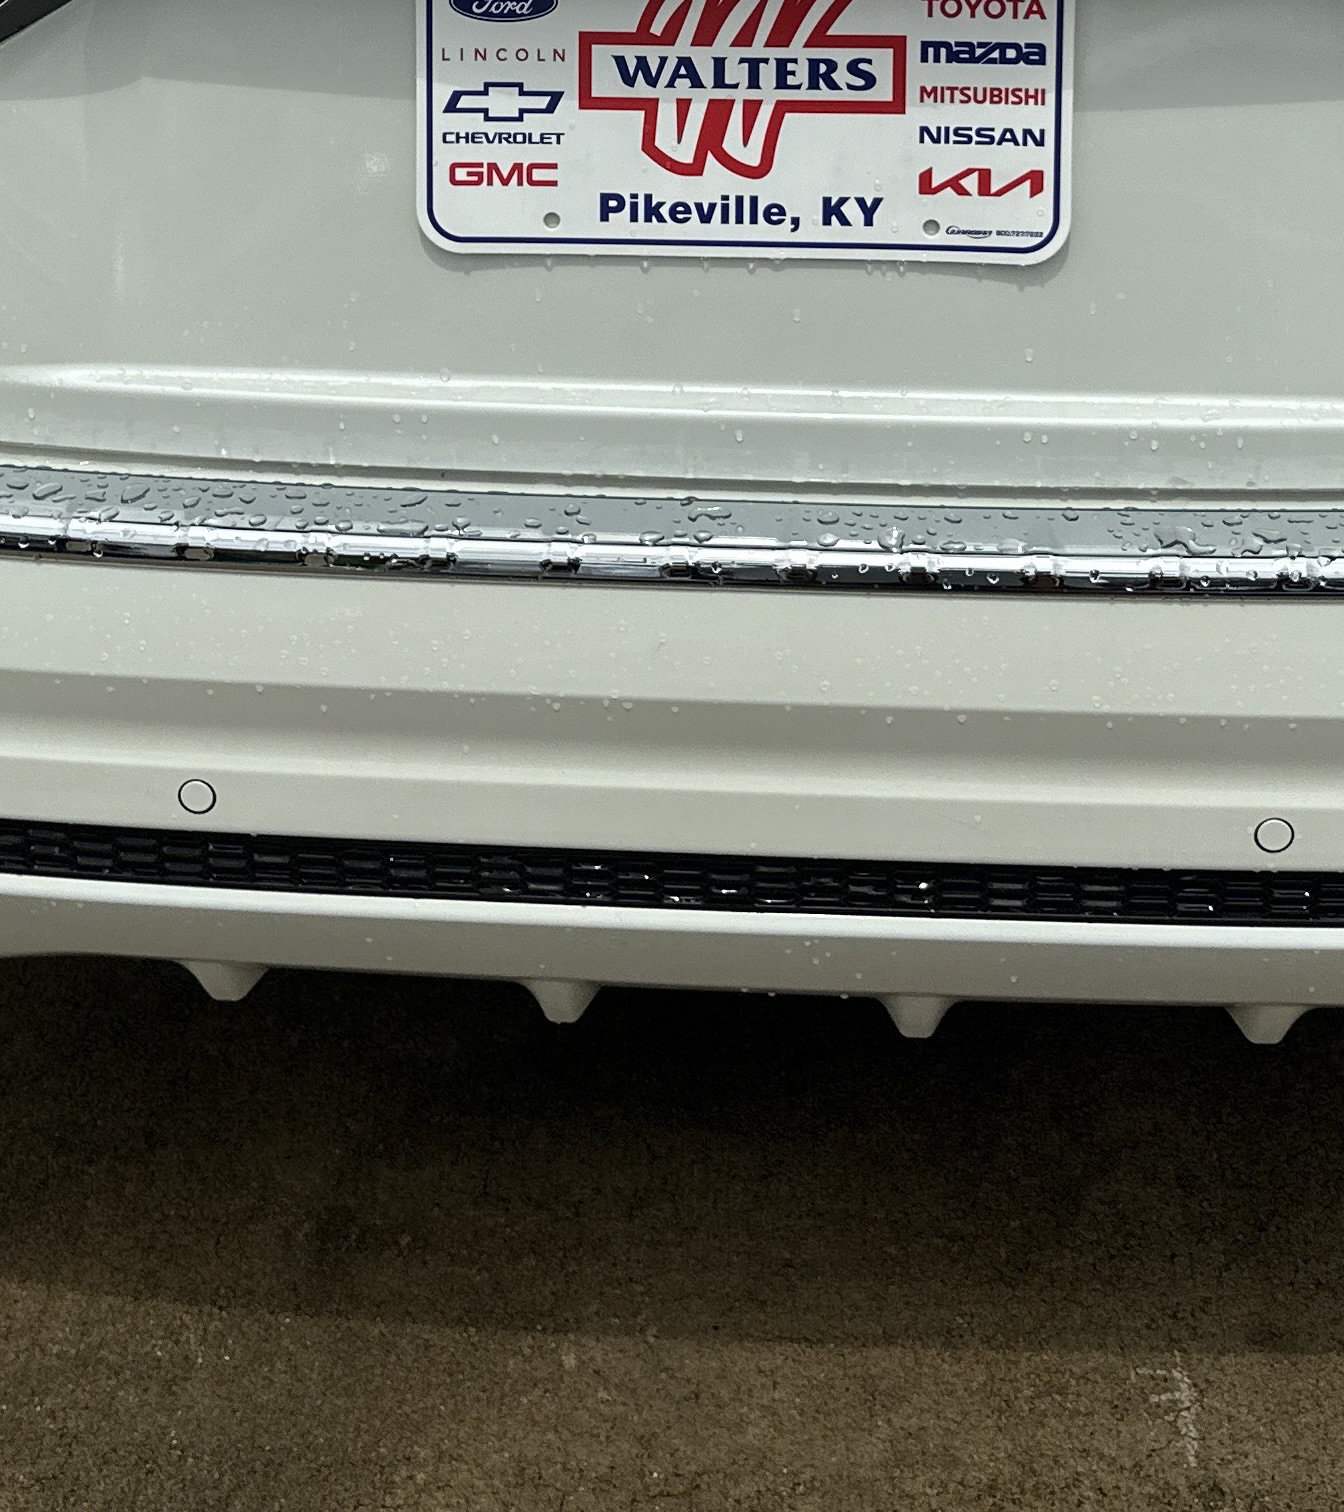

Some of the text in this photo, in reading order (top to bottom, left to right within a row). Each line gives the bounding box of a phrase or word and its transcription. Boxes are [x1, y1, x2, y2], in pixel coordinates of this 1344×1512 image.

[441, 47, 566, 62] LINCOLN
[611, 54, 877, 91] WALTERS
[919, 85, 1046, 106] MITSUBISHI
[442, 131, 565, 145] CHEVROLET
[919, 125, 1046, 147] NISSAN
[449, 162, 558, 187] GMC
[599, 192, 884, 232] Pikeville, KY
